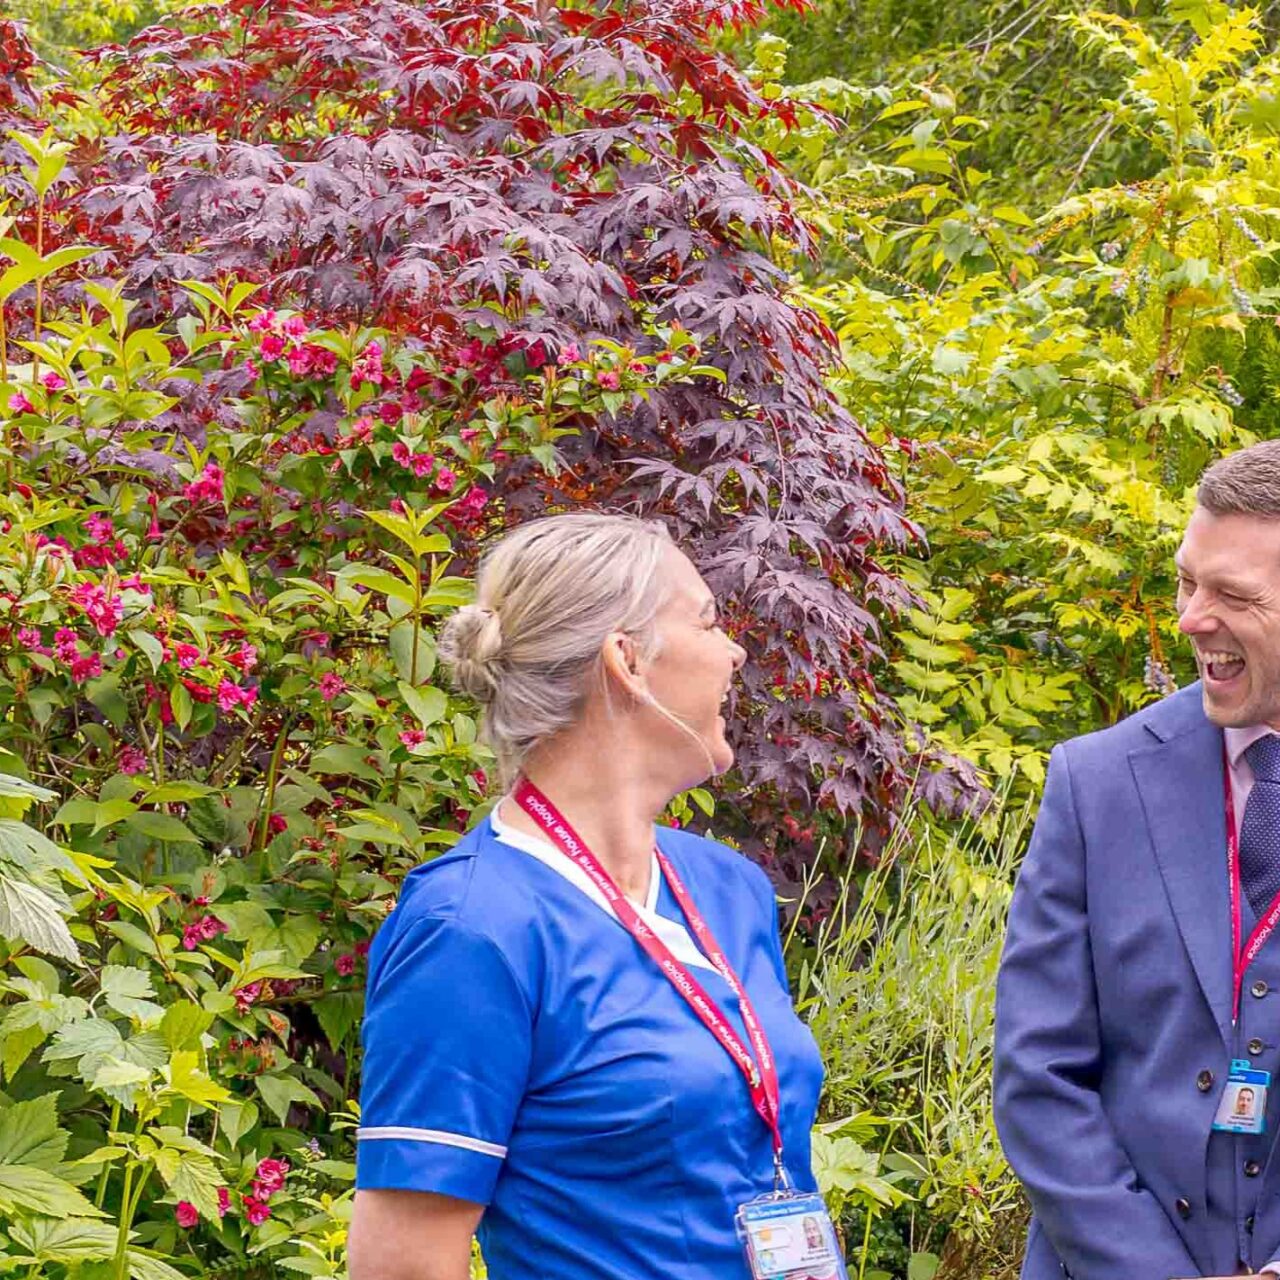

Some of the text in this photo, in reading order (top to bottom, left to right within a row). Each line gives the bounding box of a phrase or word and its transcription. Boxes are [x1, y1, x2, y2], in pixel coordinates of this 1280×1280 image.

[526, 796, 557, 828] hospice
[554, 825, 582, 857] house
[1247, 926, 1273, 959] hospice
[663, 960, 695, 996] hospice
[694, 996, 720, 1025] house
